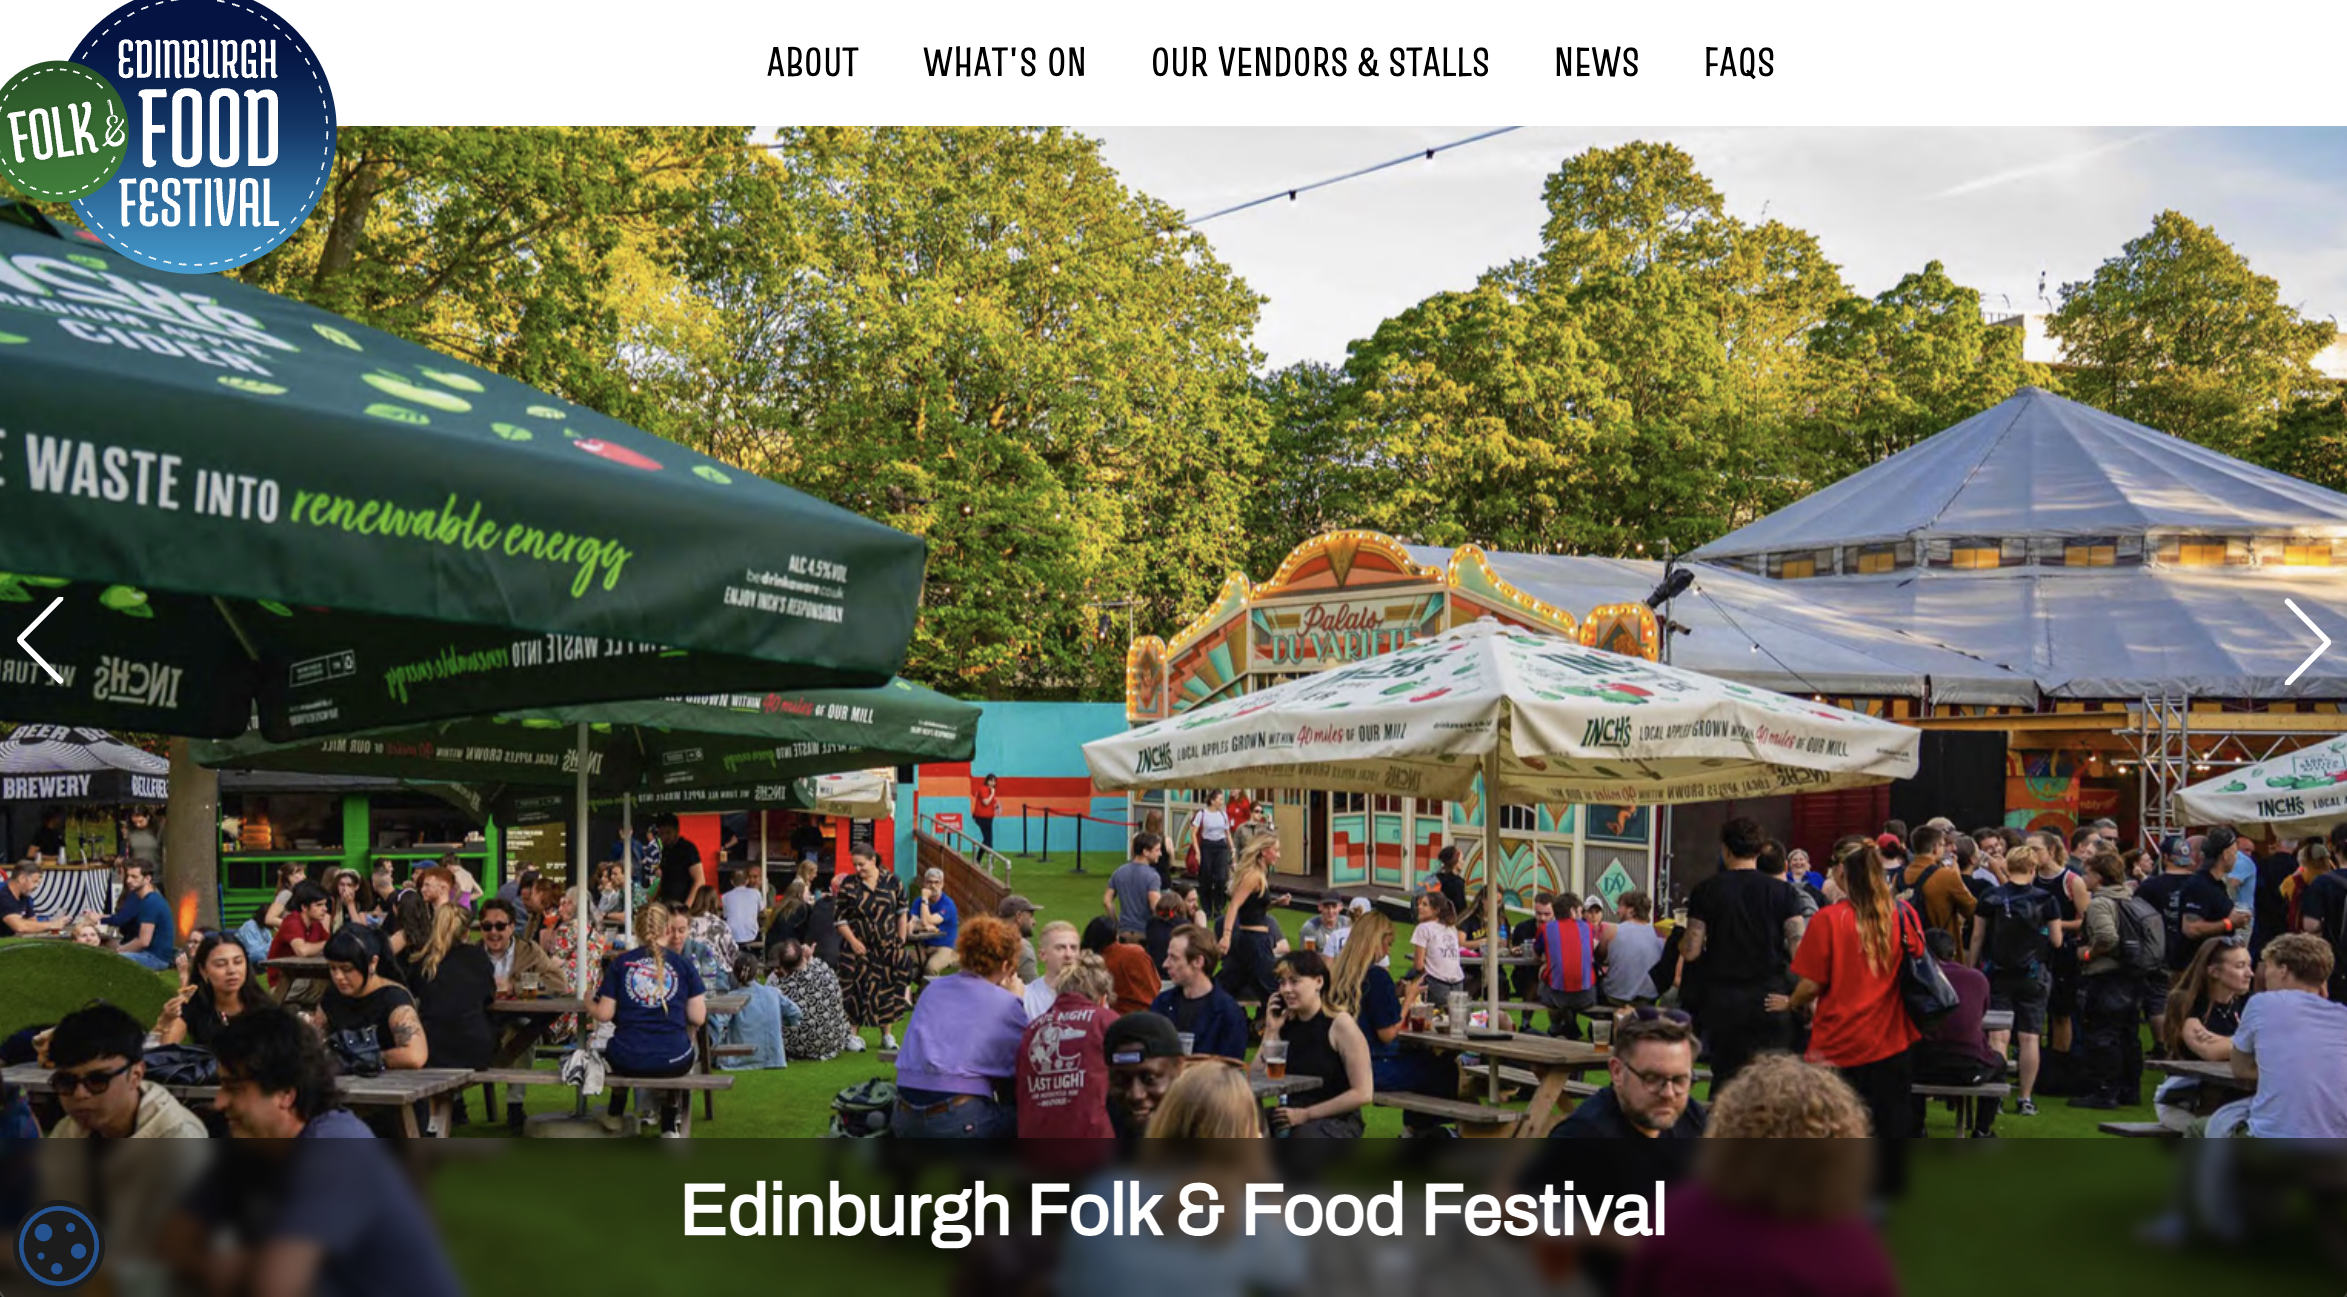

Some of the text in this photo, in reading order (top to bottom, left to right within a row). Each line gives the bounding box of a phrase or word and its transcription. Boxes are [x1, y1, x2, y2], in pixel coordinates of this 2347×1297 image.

[58, 318, 274, 377] CIDER
[25, 433, 182, 510] WASTE
[194, 469, 279, 523] INTO
[290, 489, 502, 550] renewable
[503, 523, 633, 598] energy
[723, 586, 757, 608] ENJOY
[1296, 602, 1384, 637] Palais
[1272, 634, 1305, 665] DU
[731, 694, 760, 710] WITHIN
[763, 692, 781, 714] 40
[781, 694, 815, 716] miles
[815, 704, 827, 717] OF
[827, 703, 849, 721] OUR
[850, 705, 874, 724] MILL
[8, 724, 71, 741] BEER
[1136, 741, 1173, 774] INCH'S
[1177, 745, 1199, 761] LOCAL
[1201, 740, 1229, 757] APPLES
[1231, 731, 1266, 752] GROWN
[1297, 724, 1313, 748] 40
[1314, 723, 1344, 744] miles
[1358, 724, 1380, 742] OUR
[1383, 722, 1407, 741] MILL
[1580, 716, 1632, 748] INCH'S
[1639, 725, 1663, 741] LOCAL
[1692, 719, 1729, 738] GROWN
[1755, 724, 1769, 747] 40
[1769, 729, 1796, 749] miles
[1806, 737, 1824, 753] OUR
[1826, 739, 1849, 757] MILL
[3, 774, 91, 800] BREWERY
[131, 774, 170, 799] BELLFIEL
[2256, 795, 2341, 817] INCH'S LOCAL
[1027, 1070, 1086, 1093] LAST LIGHT
